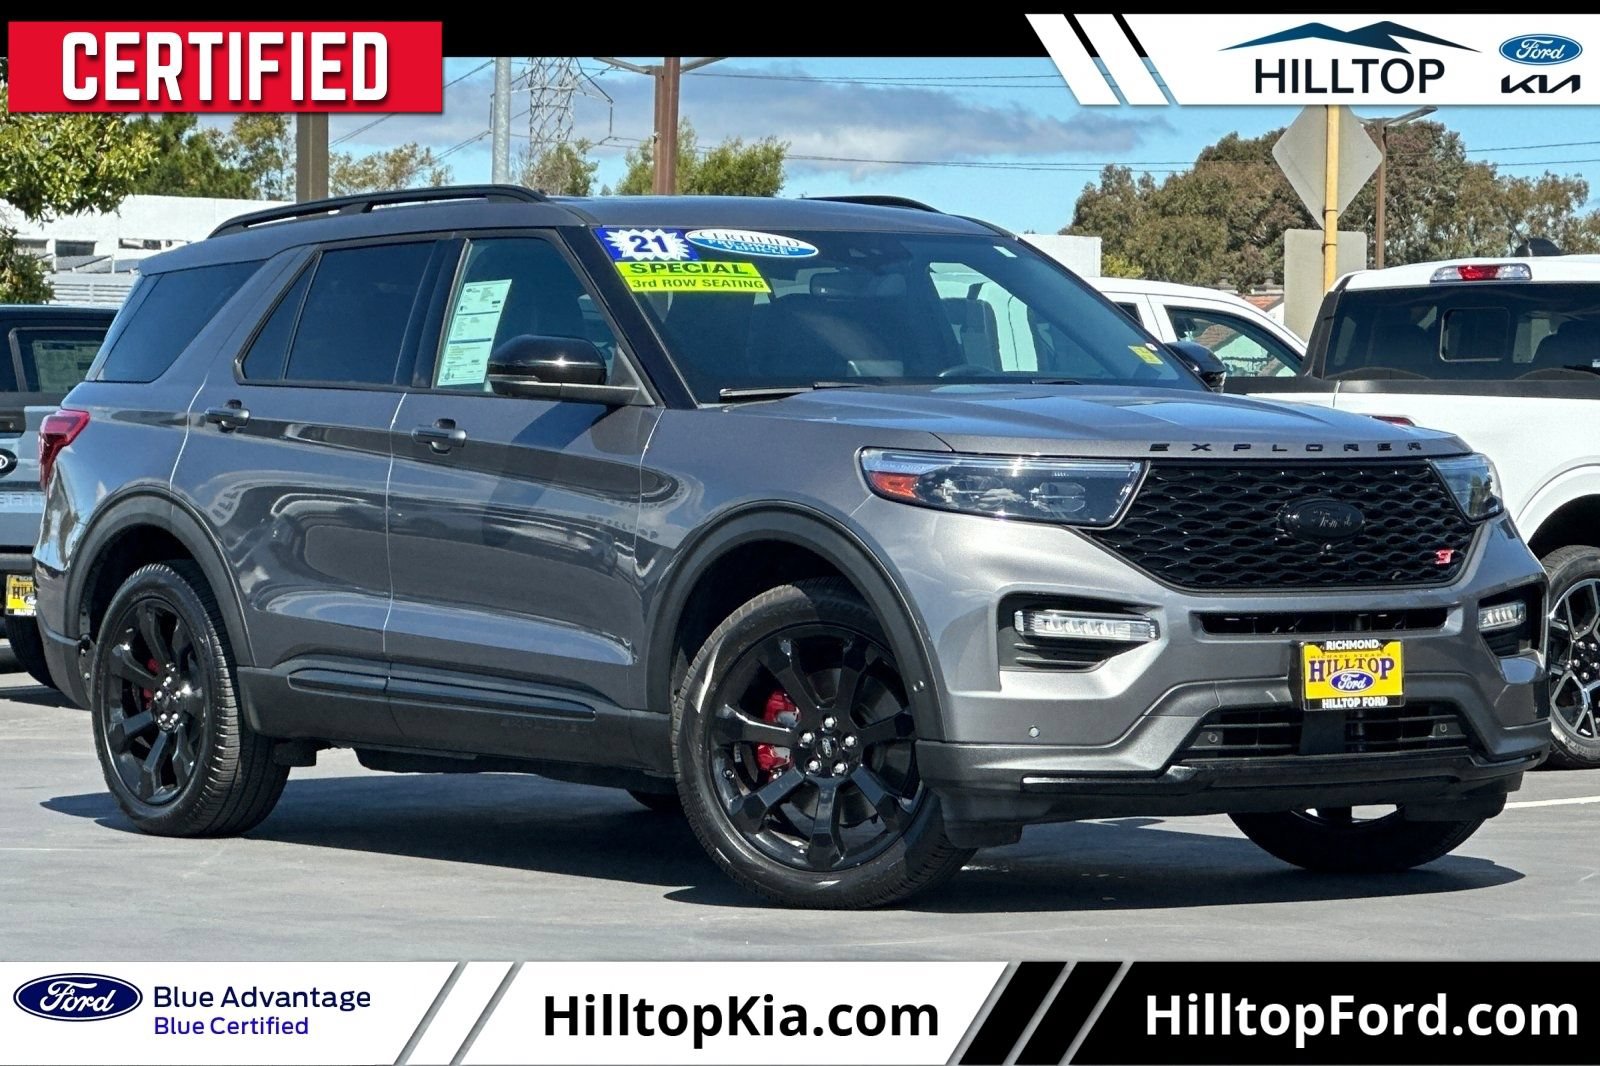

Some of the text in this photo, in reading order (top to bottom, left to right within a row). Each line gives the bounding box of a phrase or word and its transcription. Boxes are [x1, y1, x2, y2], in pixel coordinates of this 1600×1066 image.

[628, 234, 668, 253] 21
[630, 262, 749, 275] SPECIAL
[632, 278, 764, 290] 3rd ROW SEATING
[1150, 442, 1422, 452] EXPLORER
[1326, 639, 1380, 650] RICHMOND
[1309, 657, 1394, 683] HILLTOP
[1337, 672, 1367, 690] Ford
[1322, 696, 1389, 709] HILLTOP FORD
